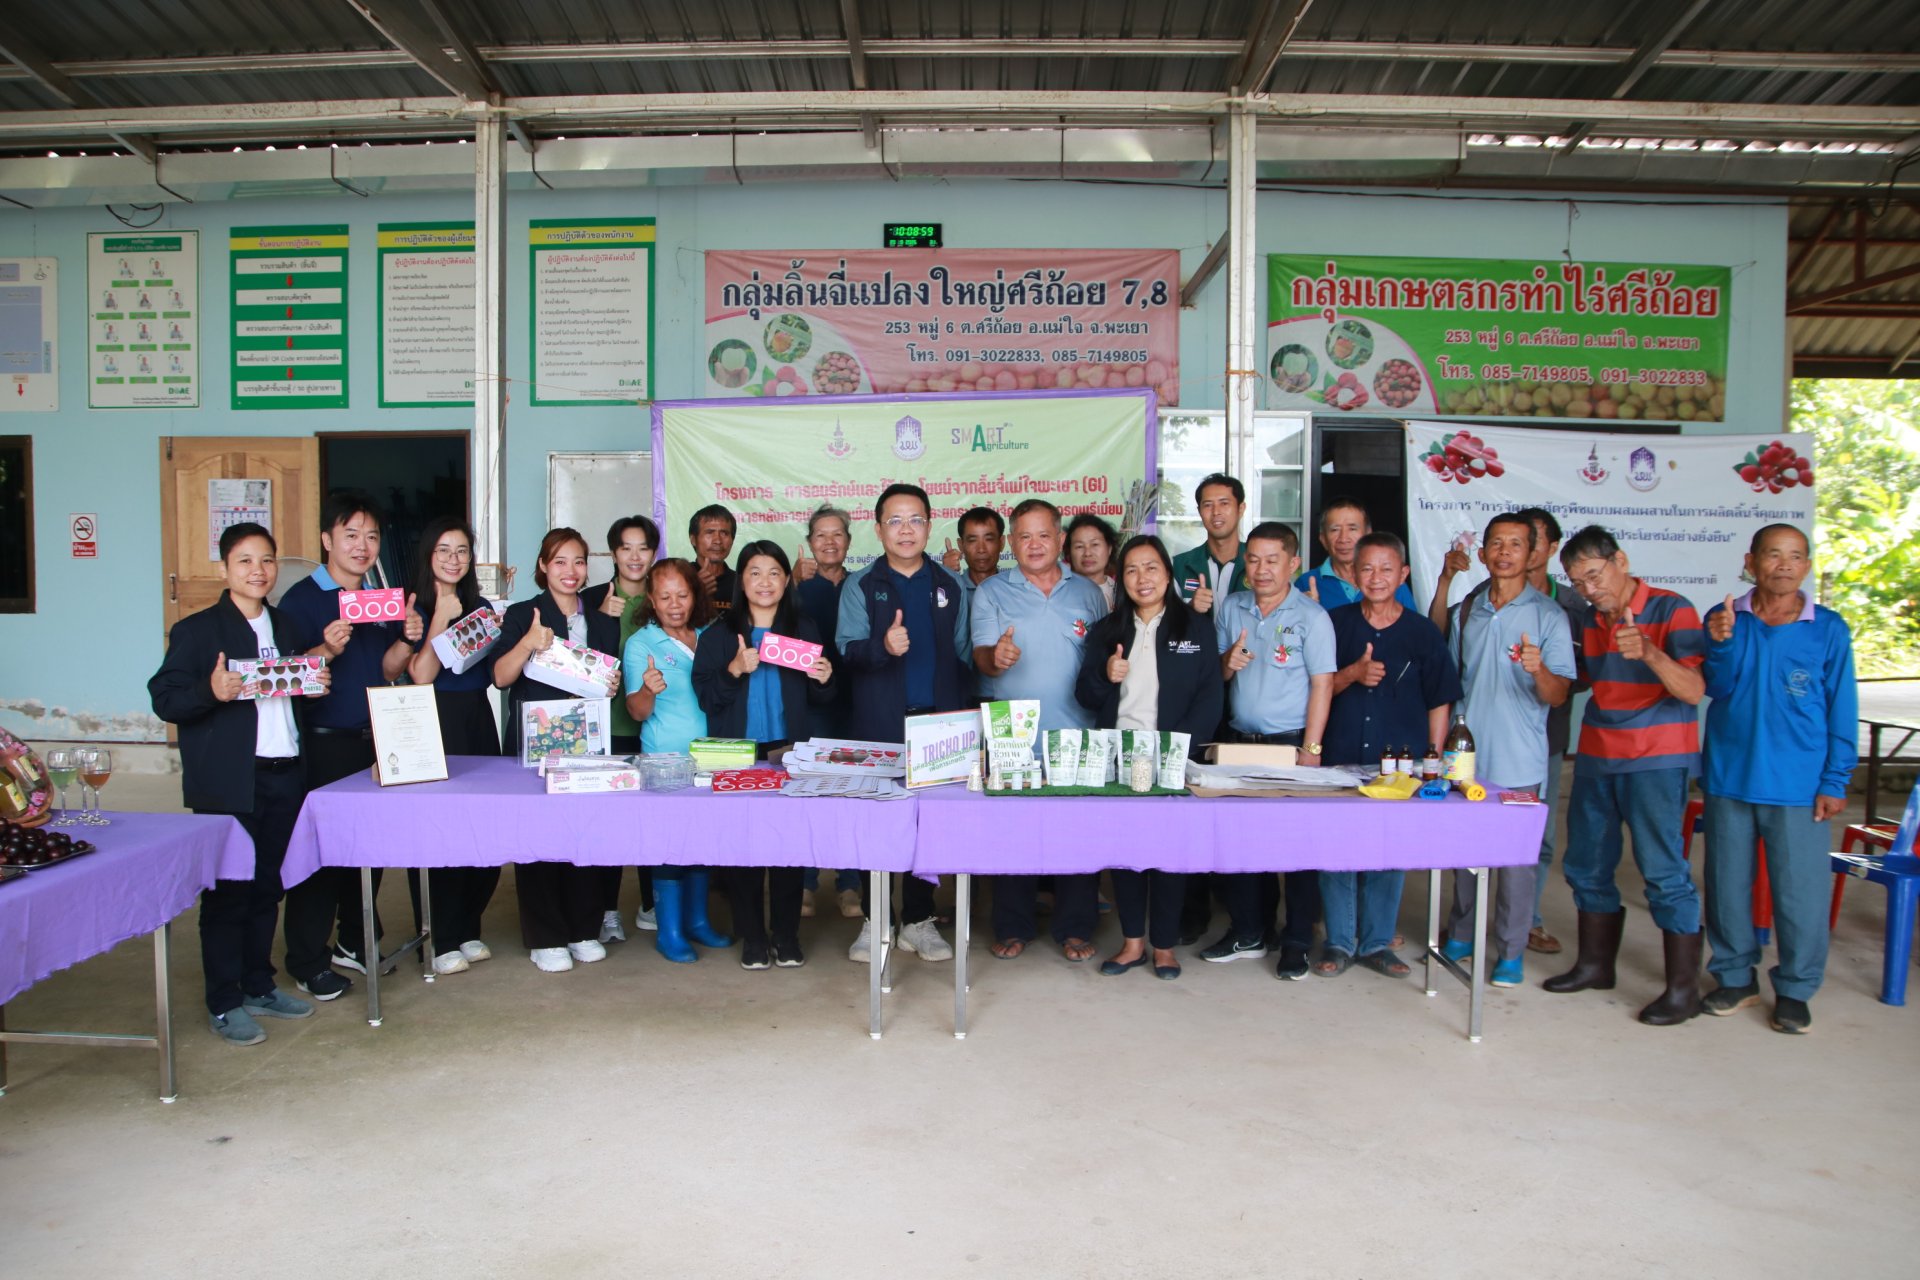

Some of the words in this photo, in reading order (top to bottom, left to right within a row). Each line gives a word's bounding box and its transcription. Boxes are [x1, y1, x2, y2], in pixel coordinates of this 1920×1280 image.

[721, 259, 1107, 320] กลุ่มลิ้นจี่แปลงใหญ่ศรีถ้อย
[1121, 278, 1170, 309] 7,8
[1291, 263, 1720, 323] กลุ่มเกษตรกรทำไร่ศรีถ้อย
[885, 320, 911, 334] 253
[918, 318, 939, 341] หมู่
[946, 321, 954, 334] 6
[961, 316, 1023, 336] ต.ศรีถ้อย
[1029, 315, 1083, 336] อ.แม่ใจ
[1090, 320, 1149, 336] จ.พะเยา
[1445, 329, 1471, 343] 253
[1477, 326, 1499, 351] หมู่
[1504, 332, 1513, 345] 6
[1519, 328, 1579, 348] ต.ศรีถ้อย
[1584, 328, 1637, 349] อ.แม่ใจ
[1643, 333, 1700, 351] จ.พะเยา
[905, 342, 939, 363] โทร.
[1051, 348, 1148, 363] 085-7149805
[1436, 356, 1474, 381] โทร.
[1600, 367, 1707, 386] 091-3022833
[715, 482, 773, 501] โครงการ
[1082, 475, 1108, 494] (GI)
[922, 735, 959, 763] TRICHO
[962, 730, 976, 752] UP
